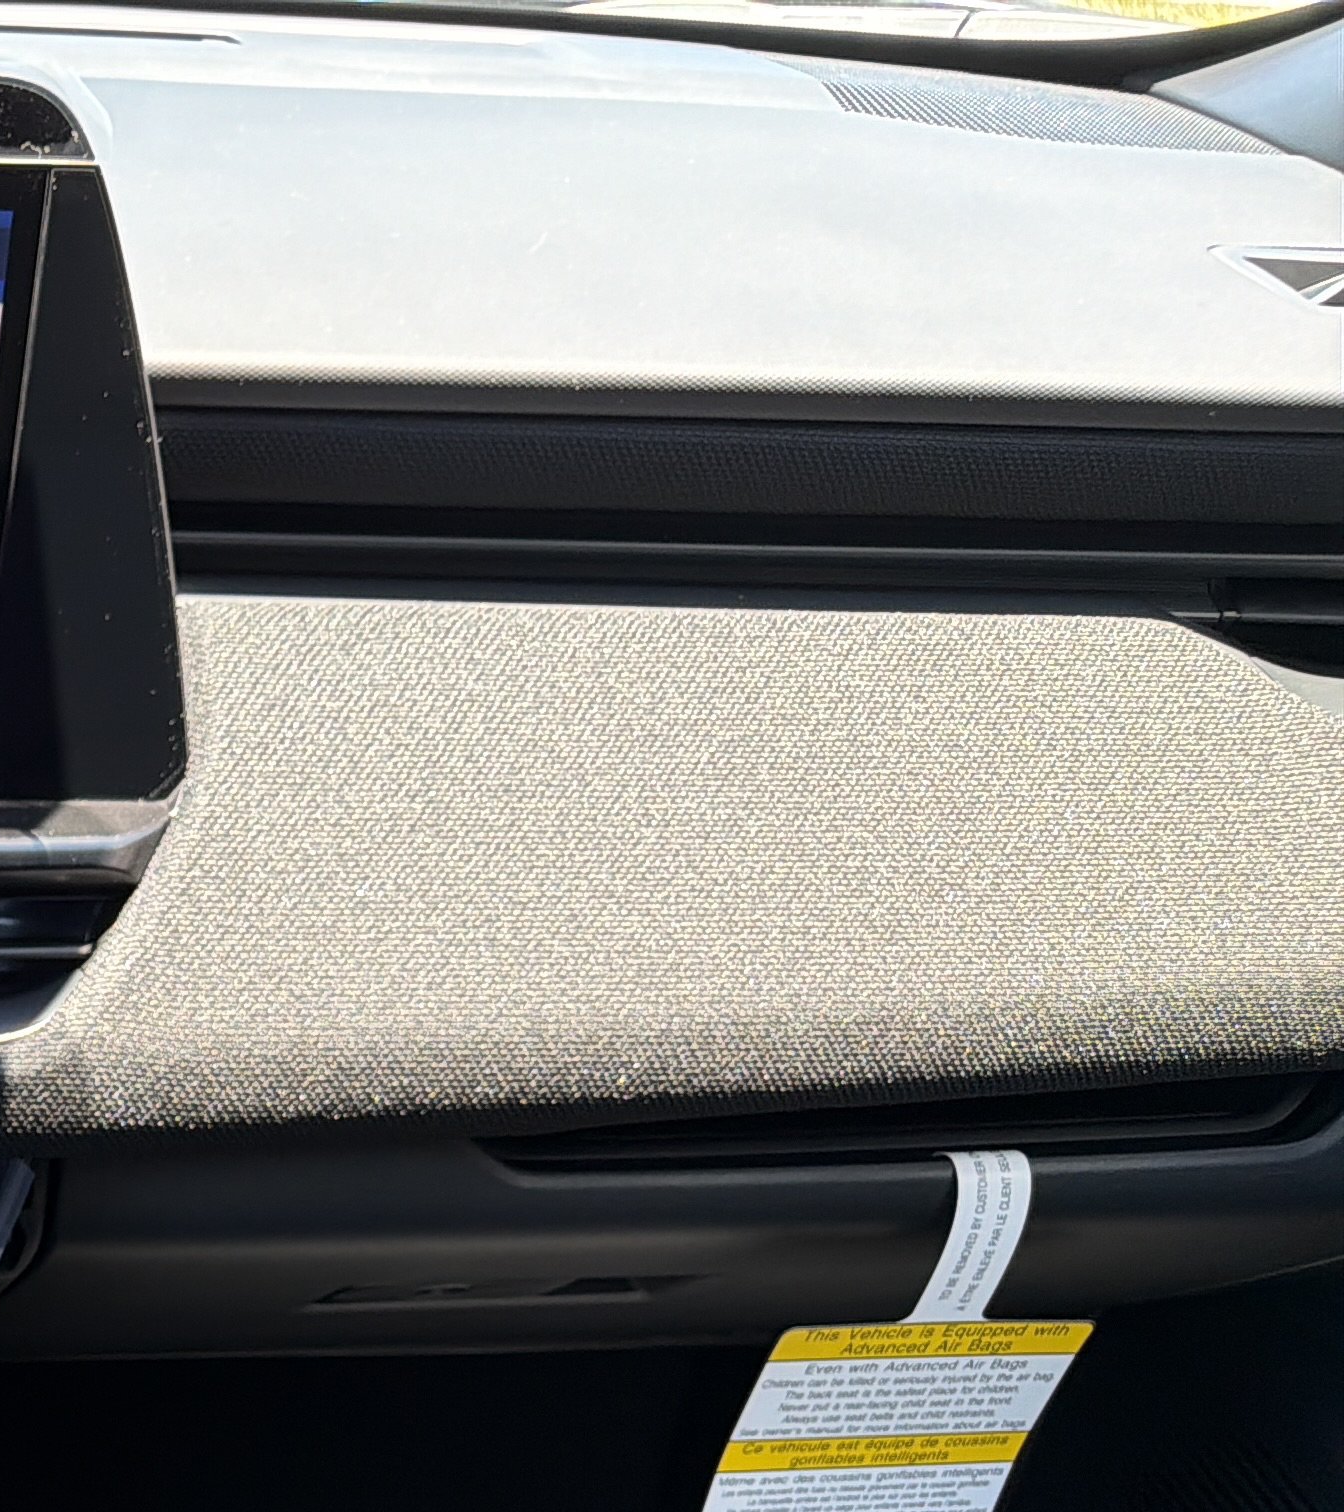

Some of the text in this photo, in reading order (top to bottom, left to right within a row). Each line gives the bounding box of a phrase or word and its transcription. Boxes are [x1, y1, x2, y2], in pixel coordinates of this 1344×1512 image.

[974, 1160, 988, 1215] CUSTOMER
[998, 1176, 1012, 1211] CLIENT
[970, 1217, 983, 1230] BY
[995, 1213, 1008, 1226] LE
[952, 1232, 978, 1275] REMOVED
[945, 1277, 960, 1288] BE
[938, 1289, 952, 1301] TO
[803, 1323, 1070, 1342] This Vehicle is Equipped with
[838, 1337, 1013, 1355] Advanced Air Bags
[804, 1358, 1029, 1376] Even with Advanced Air Bags
[979, 1373, 994, 1383] by
[996, 1372, 1013, 1381] the
[1016, 1372, 1032, 1381] air
[741, 1441, 764, 1455] Ce
[769, 1440, 832, 1454] véhicule
[835, 1440, 862, 1452] est
[920, 1436, 939, 1449] de
[943, 1435, 1011, 1448] coussins
[789, 1449, 950, 1469] gonflables intelligents
